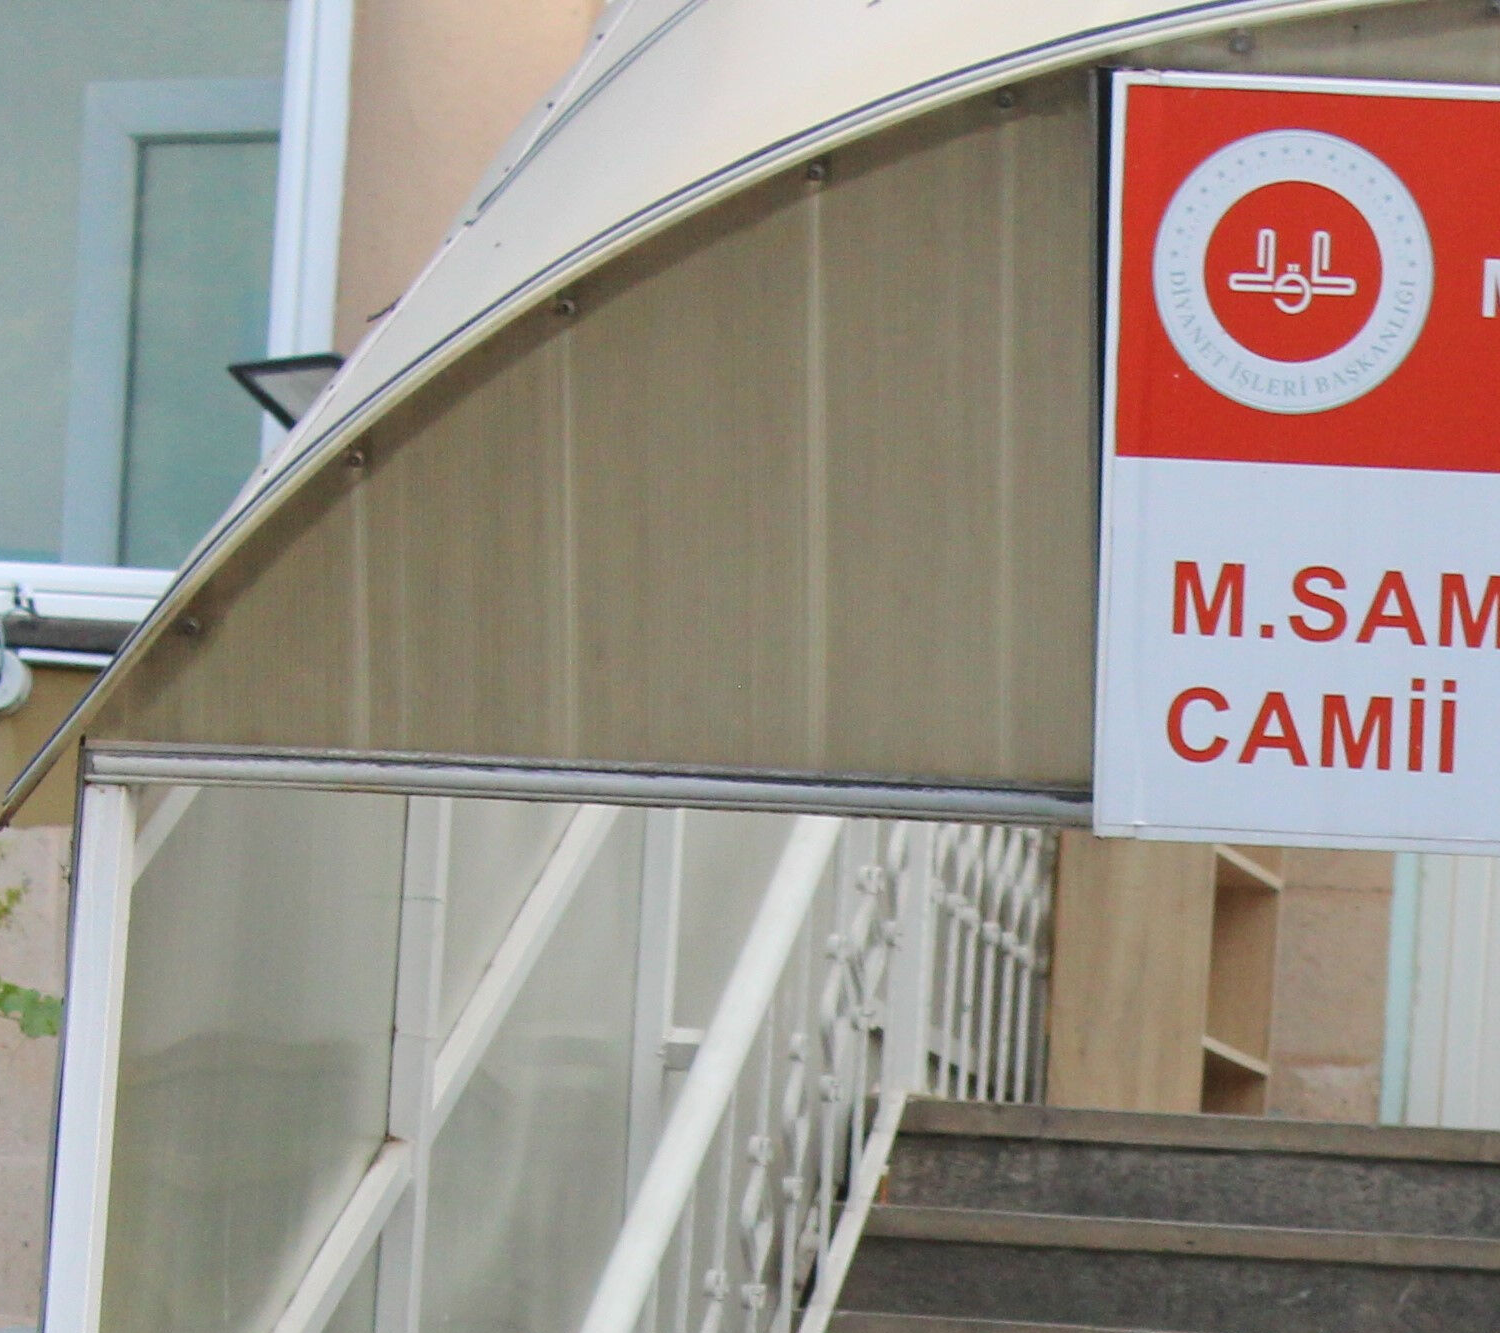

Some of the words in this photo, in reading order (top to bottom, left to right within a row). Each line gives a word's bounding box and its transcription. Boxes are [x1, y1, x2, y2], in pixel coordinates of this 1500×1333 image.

[1169, 270, 1228, 369] DİYANET
[1229, 360, 1308, 397] İŞLERİ
[1315, 279, 1416, 393] BAŞKANLIĞI
[1166, 679, 1457, 773] CAMİİ
